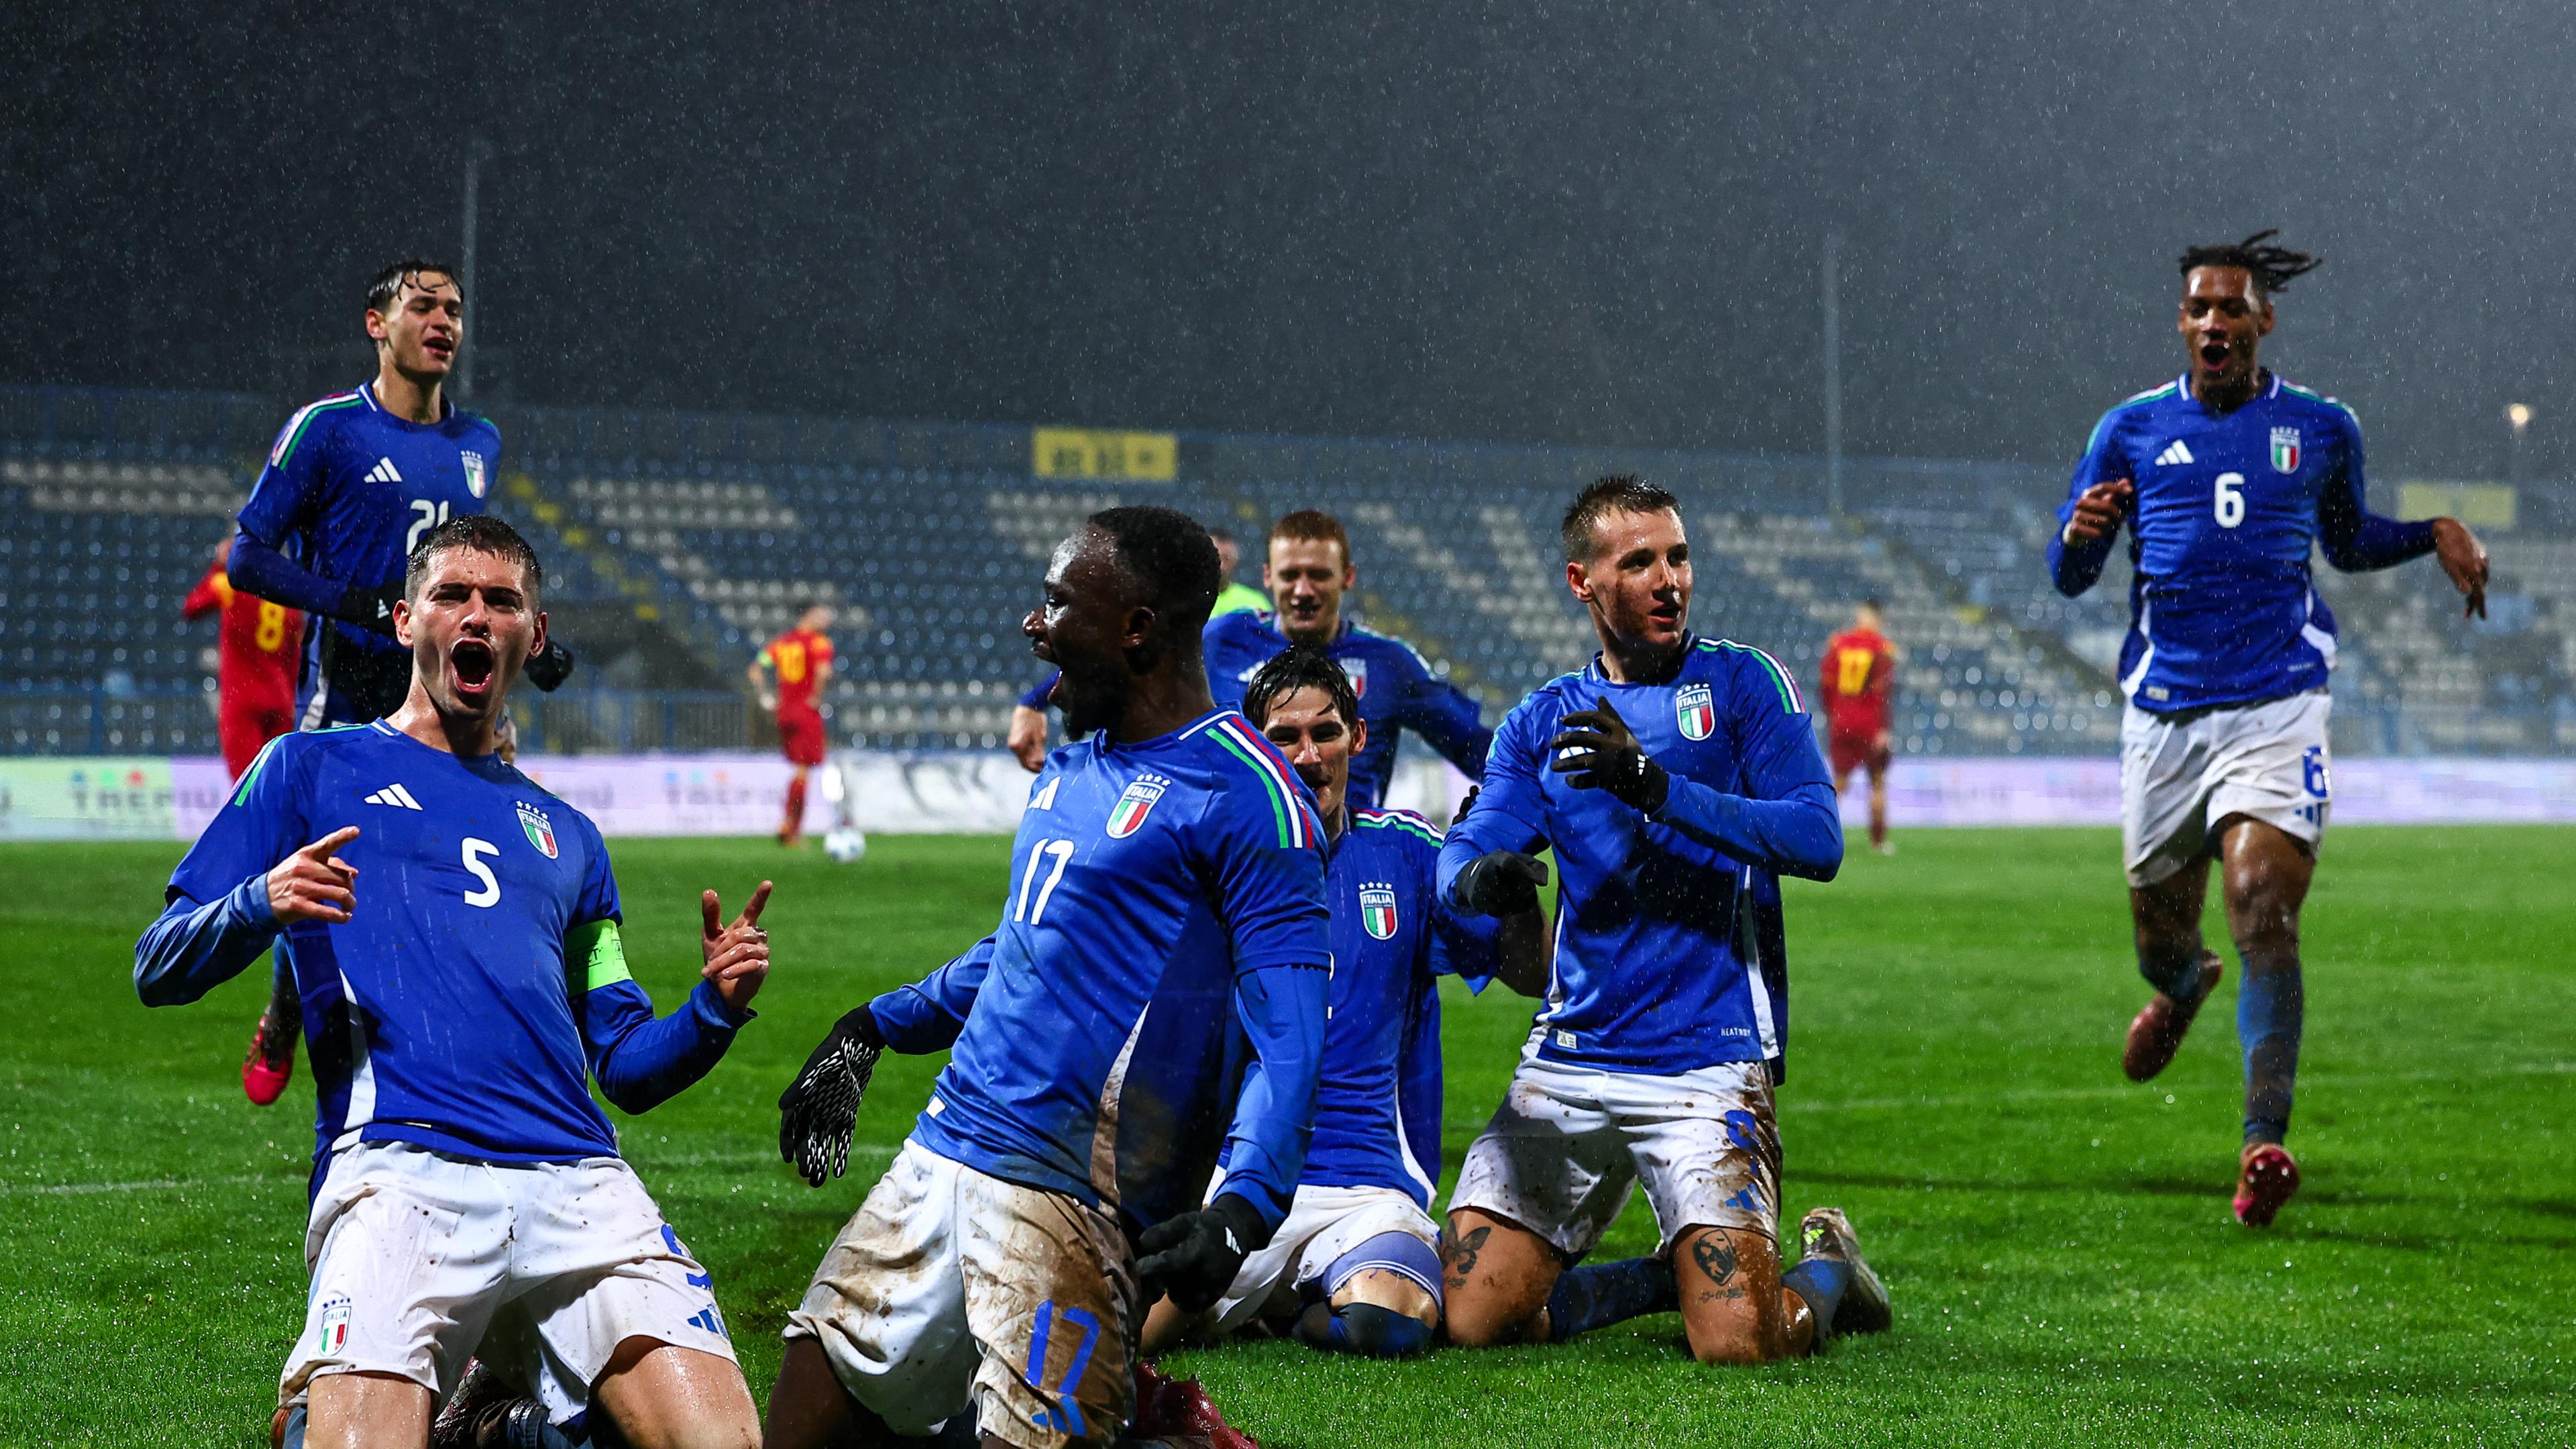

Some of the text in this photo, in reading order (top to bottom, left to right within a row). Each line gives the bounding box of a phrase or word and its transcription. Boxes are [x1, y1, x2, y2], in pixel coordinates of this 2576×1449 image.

[2214, 472, 2245, 529] 6
[255, 599, 286, 652] 8
[1679, 693, 1709, 708] ITALIA
[1126, 786, 1159, 800] ITALIA
[2303, 746, 2332, 798] 6
[521, 812, 550, 831] ITALIA
[462, 837, 501, 908] 5
[1014, 838, 1075, 926] 17
[1363, 894, 1392, 904] ITALIA
[324, 1309, 347, 1323] ITALIA
[1025, 1299, 1101, 1396] 17
